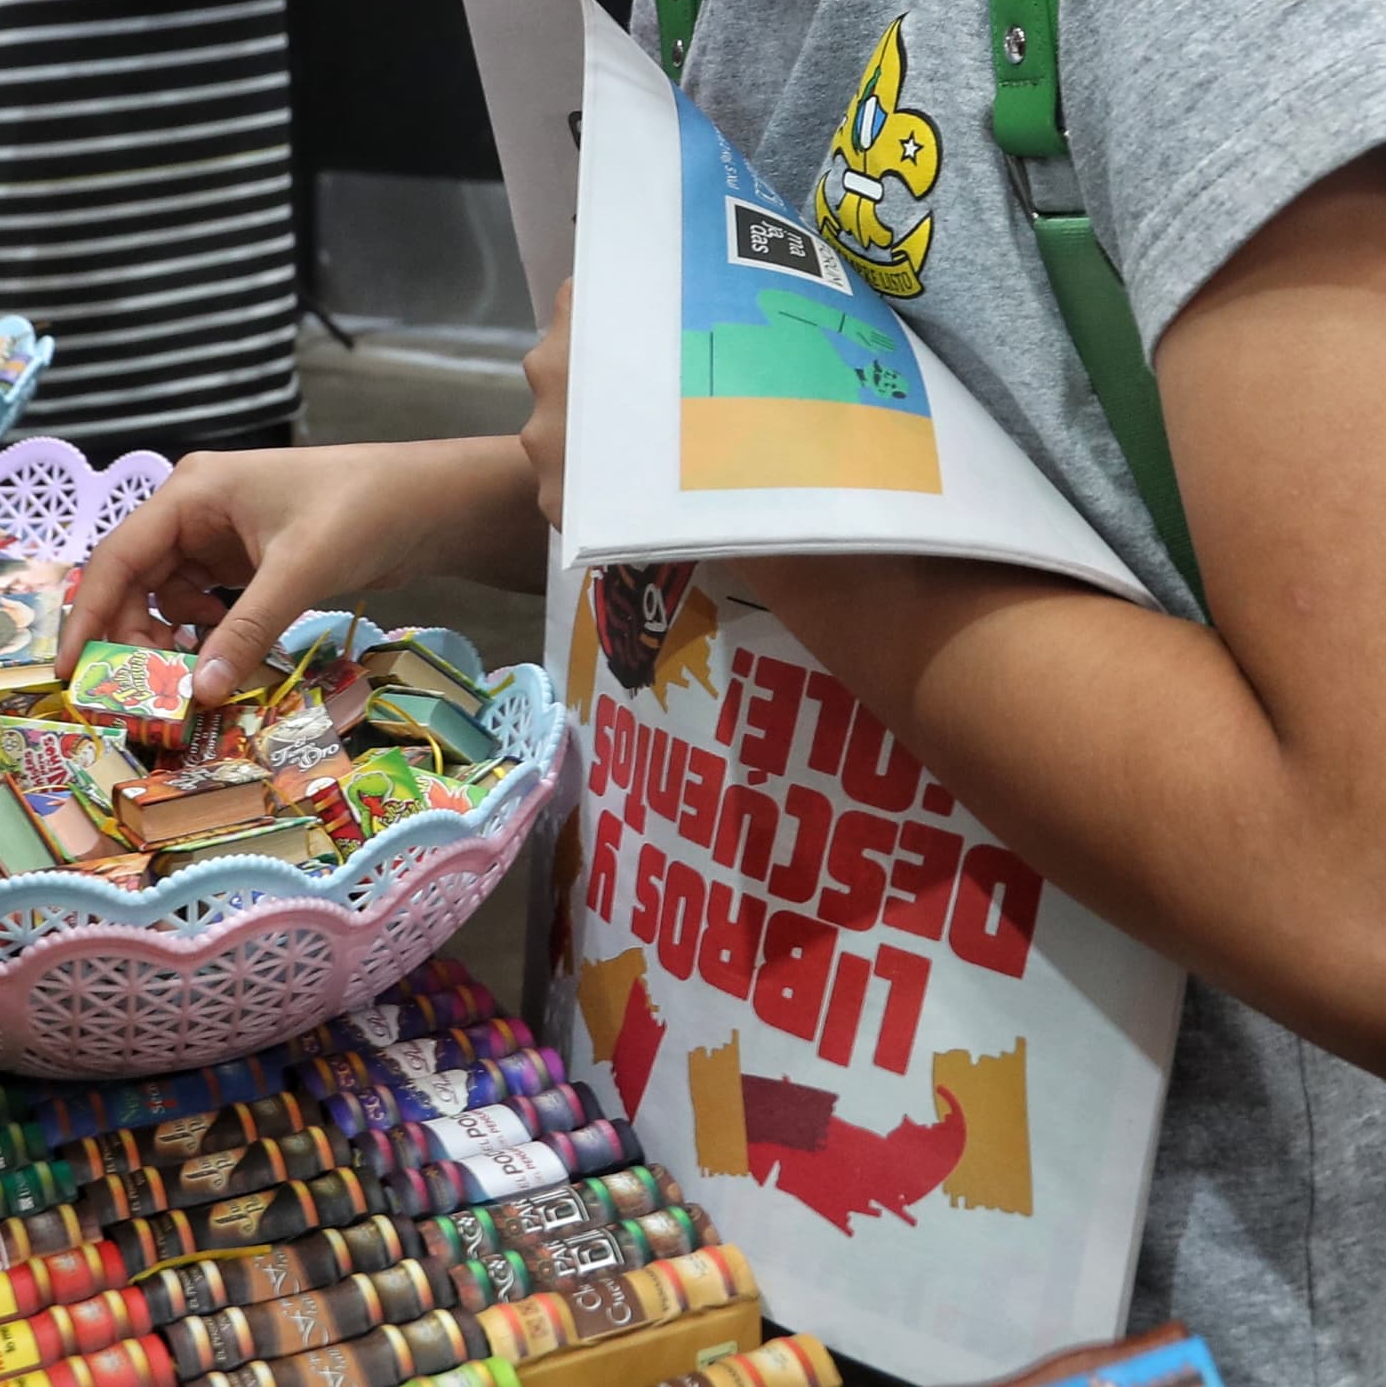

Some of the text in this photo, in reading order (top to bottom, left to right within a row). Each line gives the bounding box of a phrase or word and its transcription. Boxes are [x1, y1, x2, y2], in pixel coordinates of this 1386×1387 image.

[879, 271, 913, 292] LISTO
[587, 809, 931, 1075] LIBROS Y
[589, 694, 1043, 978] DESCUENTOS
